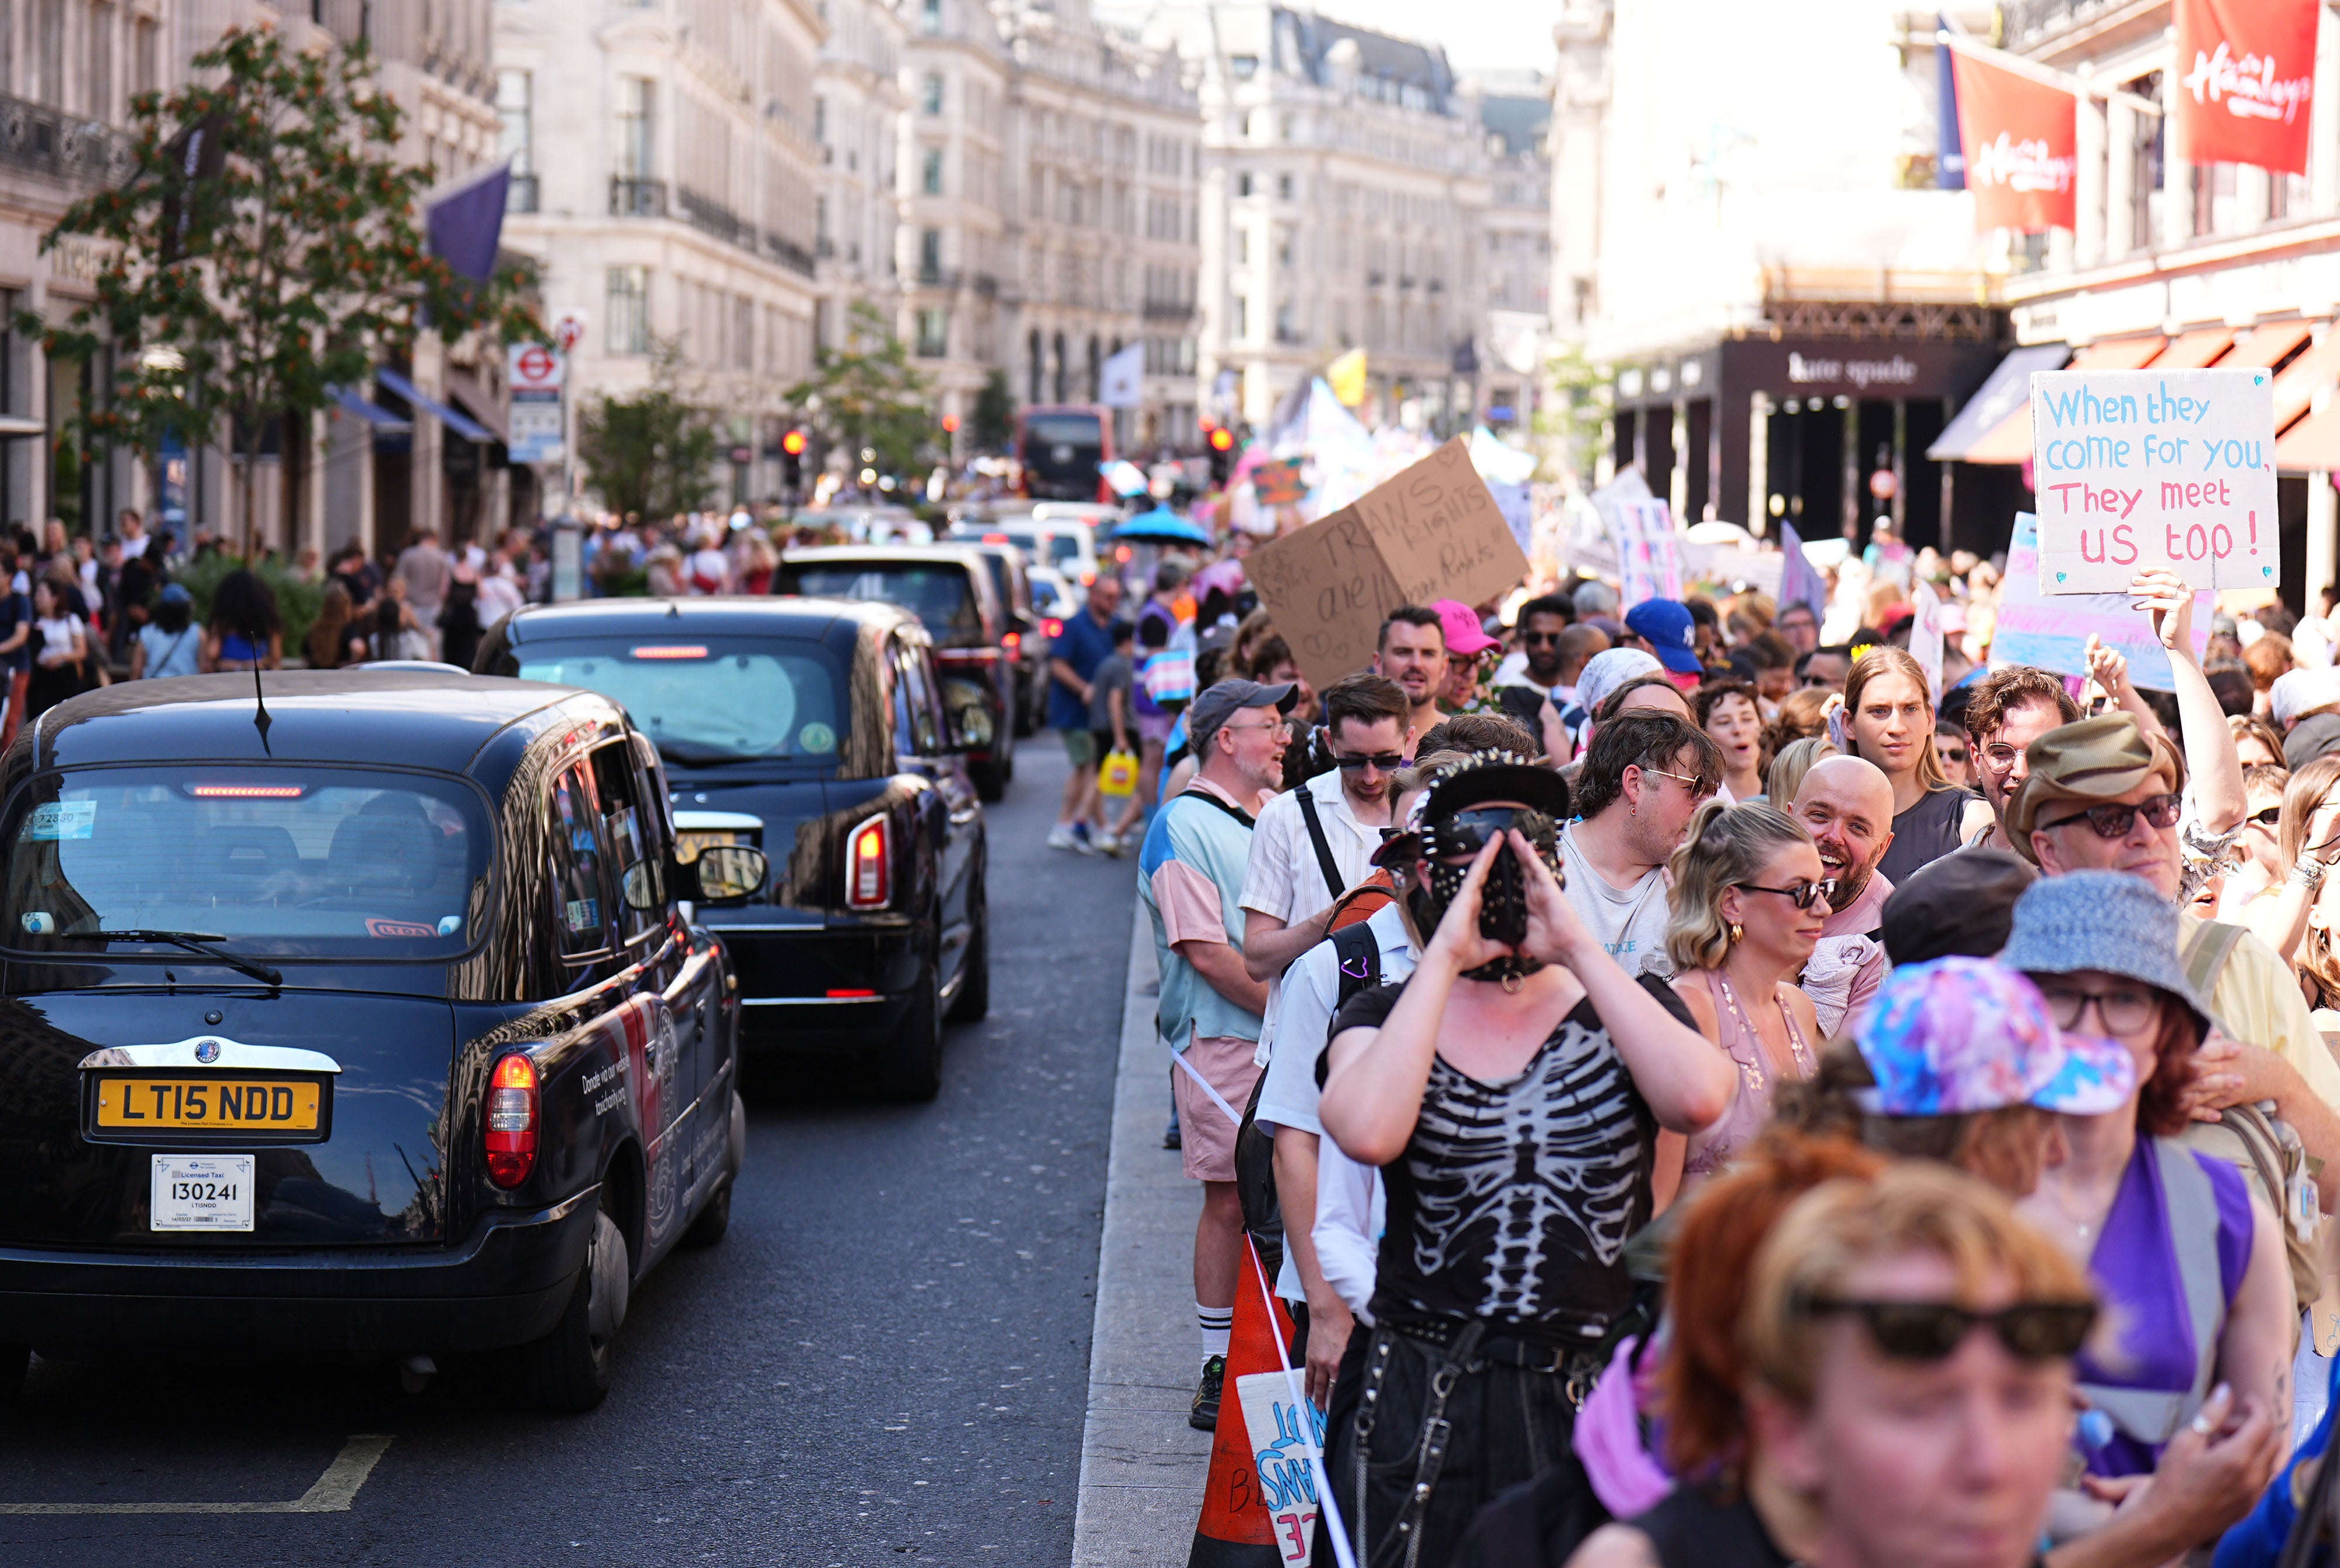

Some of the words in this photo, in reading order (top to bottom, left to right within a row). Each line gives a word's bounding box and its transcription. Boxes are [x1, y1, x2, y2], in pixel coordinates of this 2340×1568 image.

[2043, 384, 2137, 428] When
[2148, 380, 2210, 425] they
[2046, 435, 2130, 470] come
[2047, 483, 2142, 519] They
[2162, 479, 2230, 511] meet
[1317, 475, 1444, 566] TRANS
[1317, 575, 1365, 622] are
[1683, 624, 1695, 646] NY
[582, 1071, 600, 1094] Donate
[123, 1085, 207, 1119] LT15
[219, 1086, 293, 1120] NDD
[173, 1183, 236, 1200] 130241
